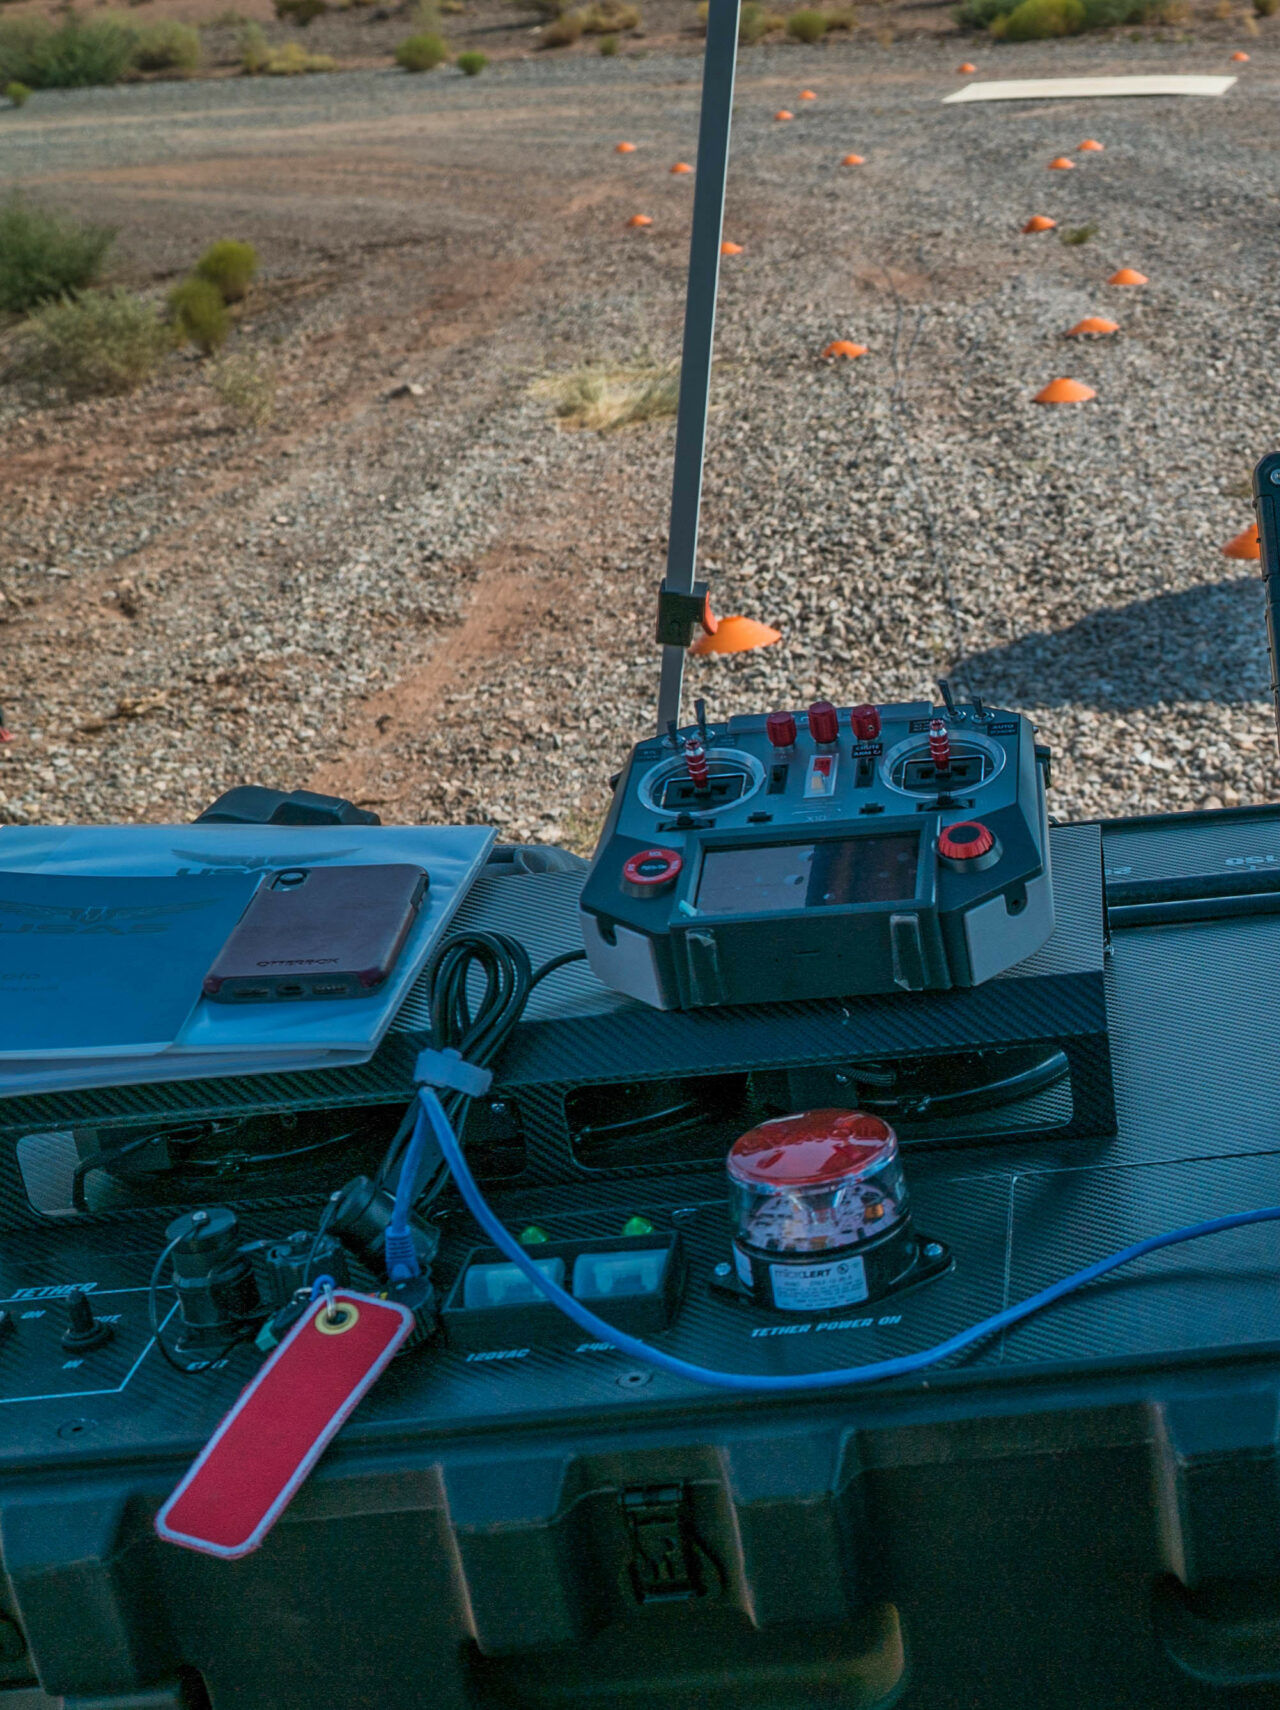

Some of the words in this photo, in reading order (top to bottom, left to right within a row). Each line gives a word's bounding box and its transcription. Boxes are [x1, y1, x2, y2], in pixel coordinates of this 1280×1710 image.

[256, 957, 340, 968] OTTERBOX
[750, 1322, 810, 1339] TETHER
[816, 1318, 866, 1334] POWER
[872, 1314, 902, 1327] ON
[466, 1348, 530, 1362] 120VAC
